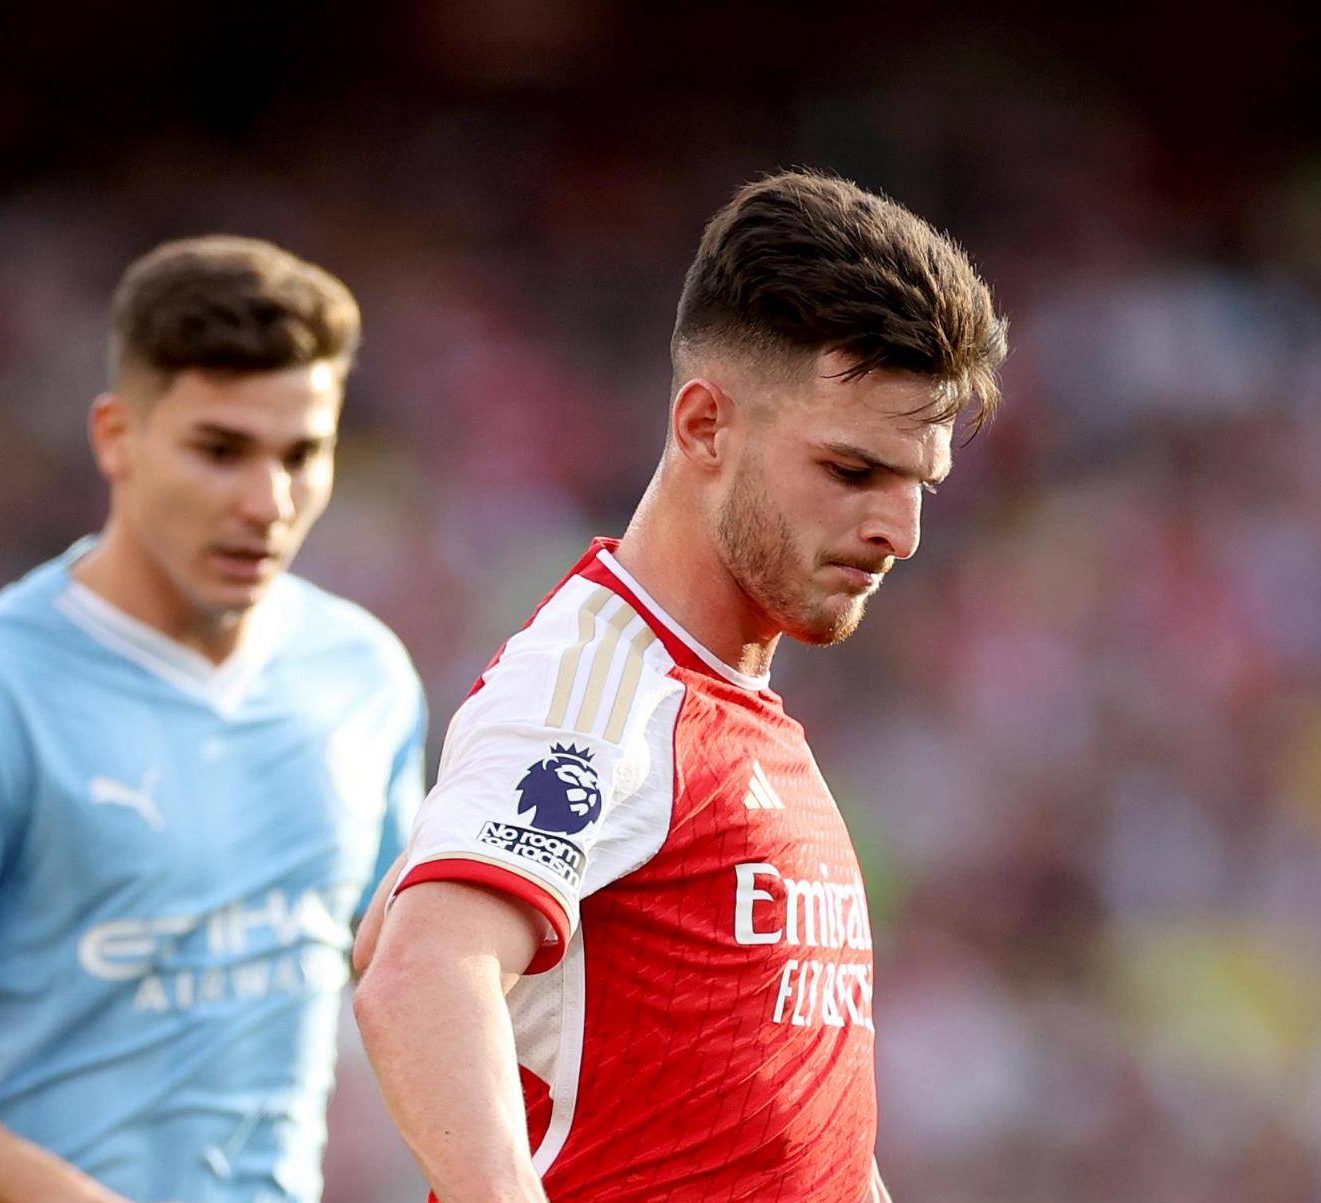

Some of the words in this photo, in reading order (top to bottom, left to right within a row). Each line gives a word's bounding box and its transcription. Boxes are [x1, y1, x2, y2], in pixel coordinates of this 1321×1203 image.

[479, 821, 518, 841] No
[519, 831, 581, 870] room
[772, 959, 824, 1027] FLY
